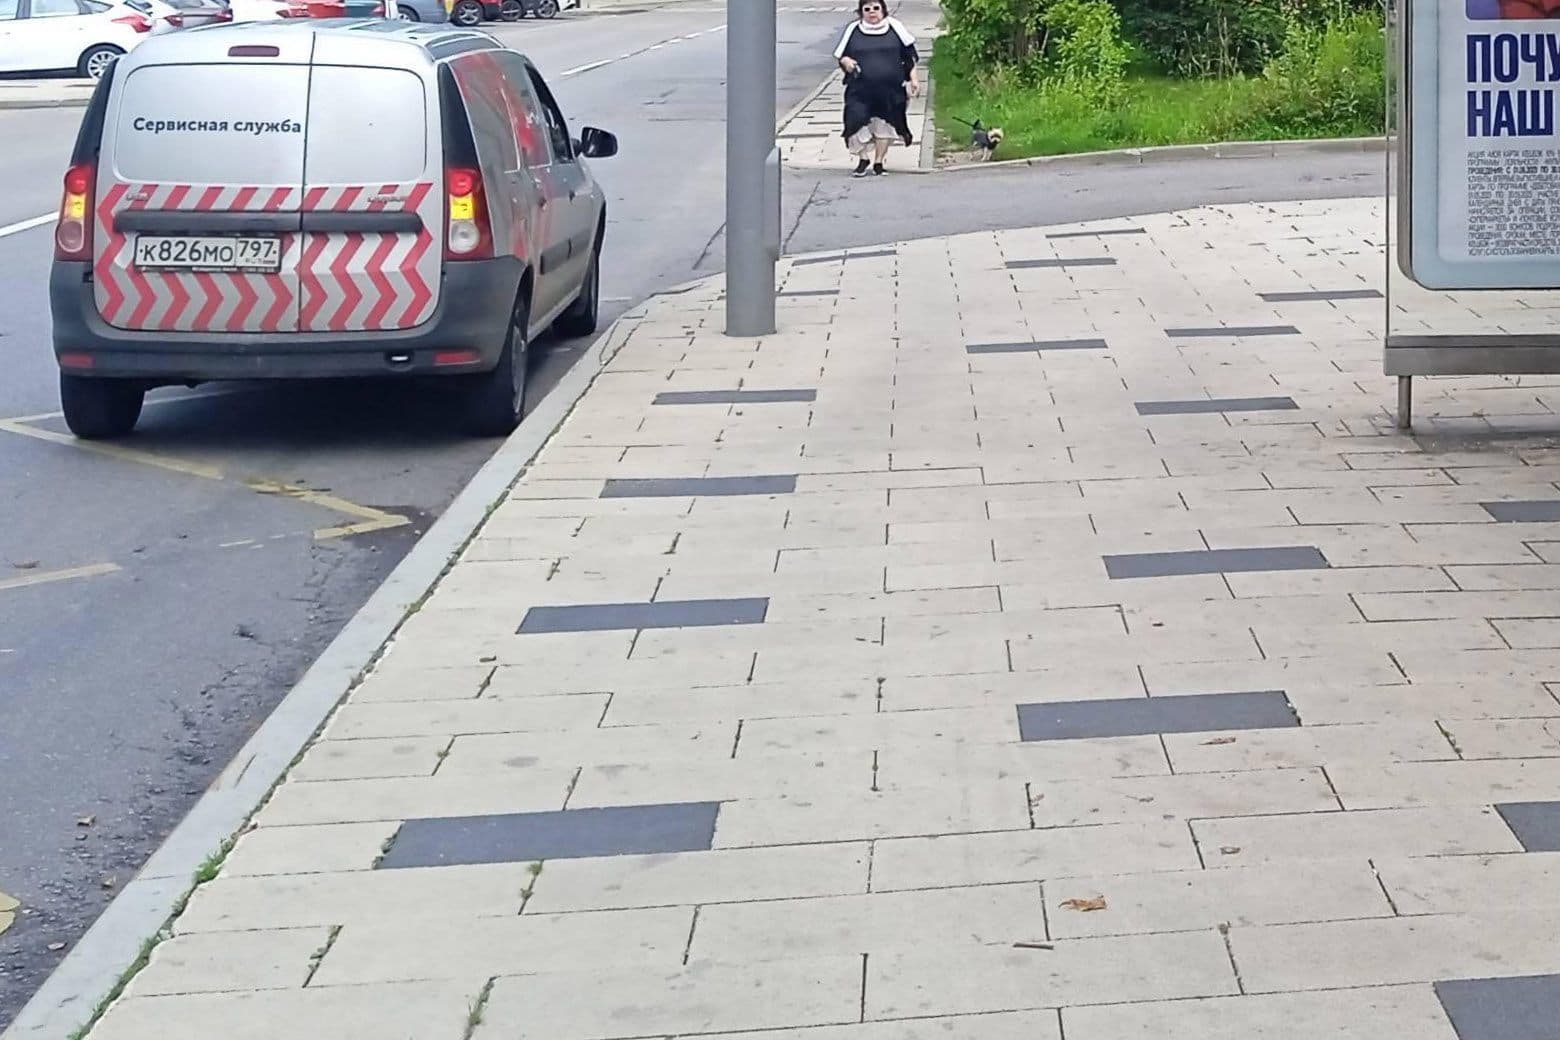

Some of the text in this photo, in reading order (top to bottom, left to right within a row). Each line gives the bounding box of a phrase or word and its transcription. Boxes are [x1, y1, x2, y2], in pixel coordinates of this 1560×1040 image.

[1467, 90, 1554, 137] НАШ
[133, 117, 302, 136] Сервисная служба
[238, 241, 275, 258] 797
